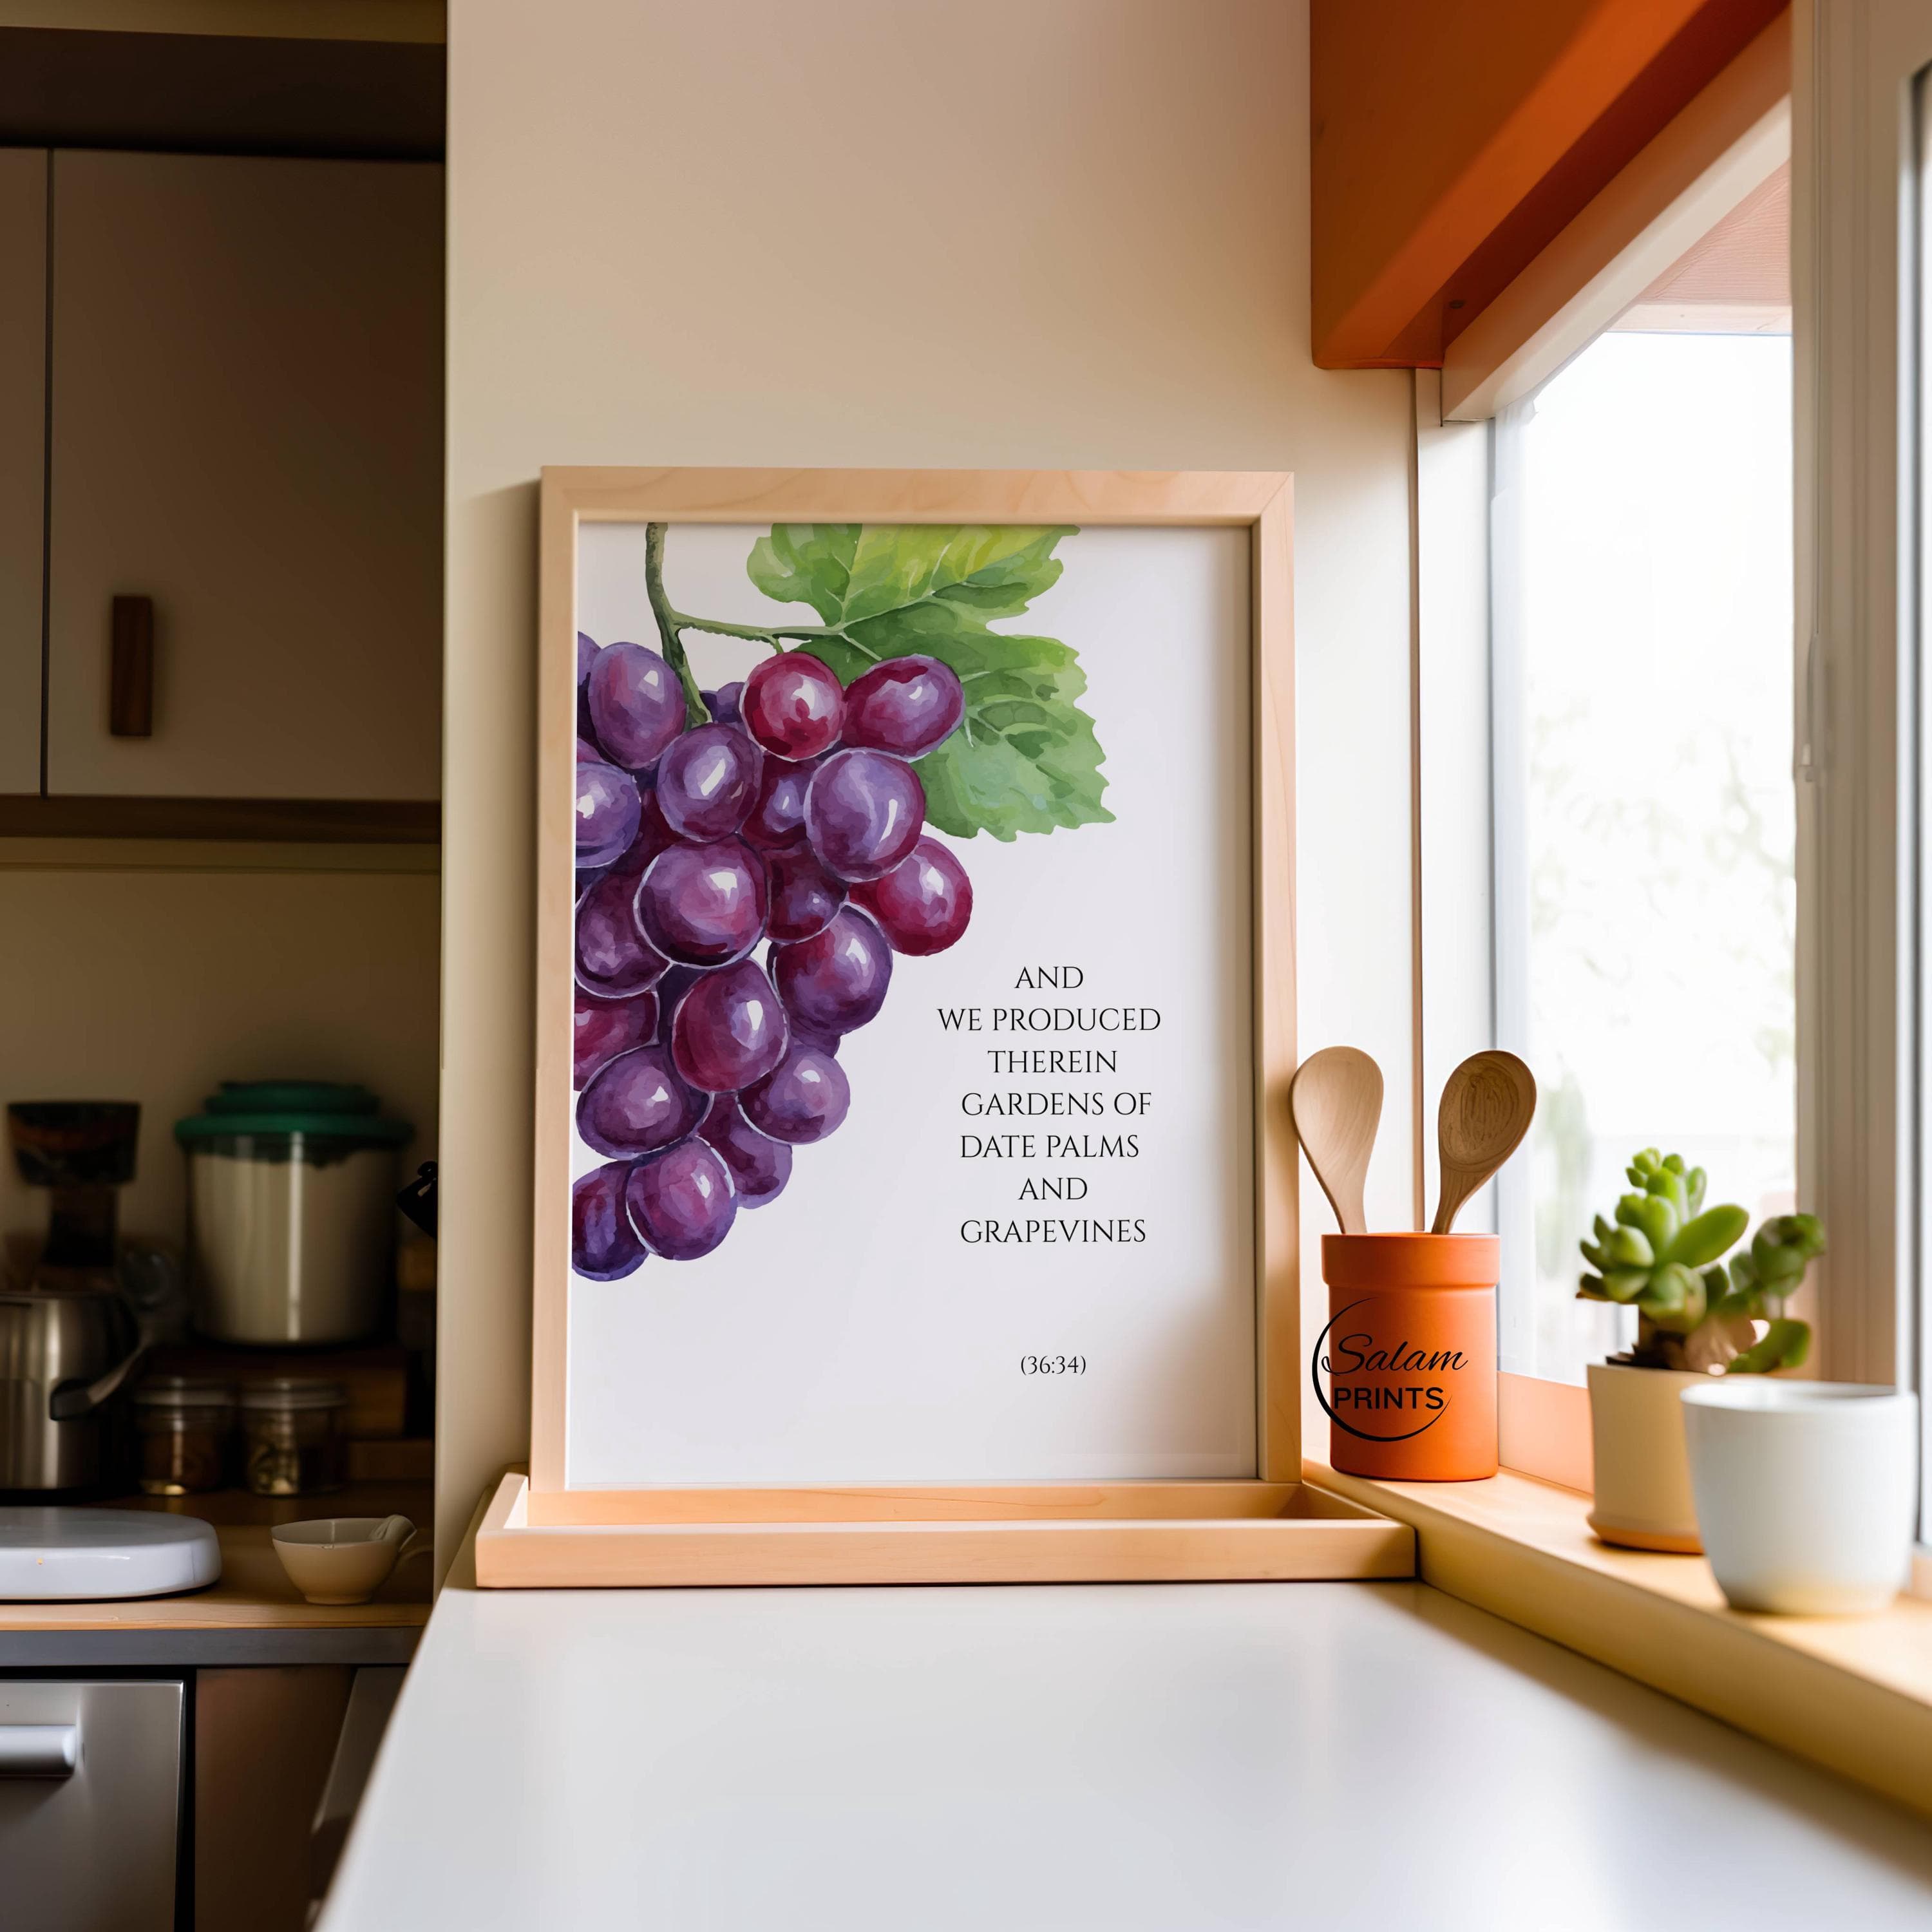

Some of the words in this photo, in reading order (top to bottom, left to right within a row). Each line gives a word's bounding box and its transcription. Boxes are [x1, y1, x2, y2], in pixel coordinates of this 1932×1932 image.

[1014, 966, 1084, 989] AND
[936, 1008, 982, 1031] WE
[992, 1008, 1161, 1031] PRODUCED
[987, 1050, 1117, 1073] THEREIN
[961, 1092, 1104, 1116] GARDENS
[1113, 1092, 1151, 1116] OF
[960, 1134, 1036, 1158] DATE
[1046, 1134, 1139, 1158] PALMS
[1018, 1177, 1088, 1200] AND
[960, 1219, 1146, 1244] GRAPEVINES
[1020, 1355, 1087, 1376] (36:34)
